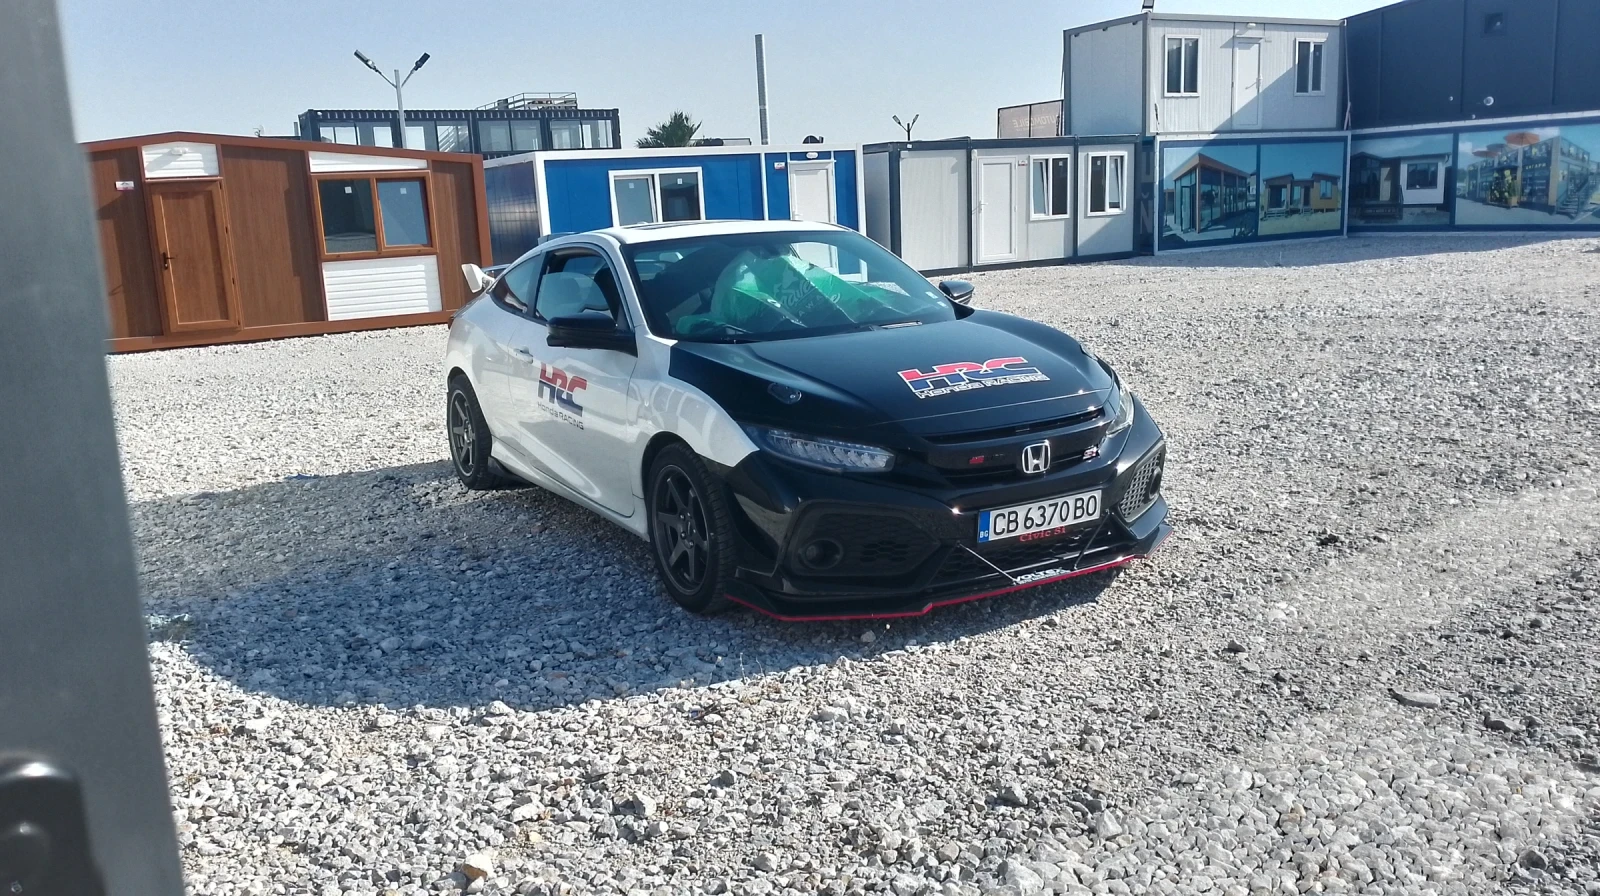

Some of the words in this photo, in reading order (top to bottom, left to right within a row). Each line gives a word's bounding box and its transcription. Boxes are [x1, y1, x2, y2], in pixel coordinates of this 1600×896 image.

[537, 362, 588, 418] HRC
[897, 356, 1043, 393] HRC
[993, 510, 1019, 536] CB
[1023, 500, 1070, 530] 6370
[1073, 494, 1098, 520] BO
[979, 530, 989, 539] BG
[1019, 529, 1052, 543] Civic
